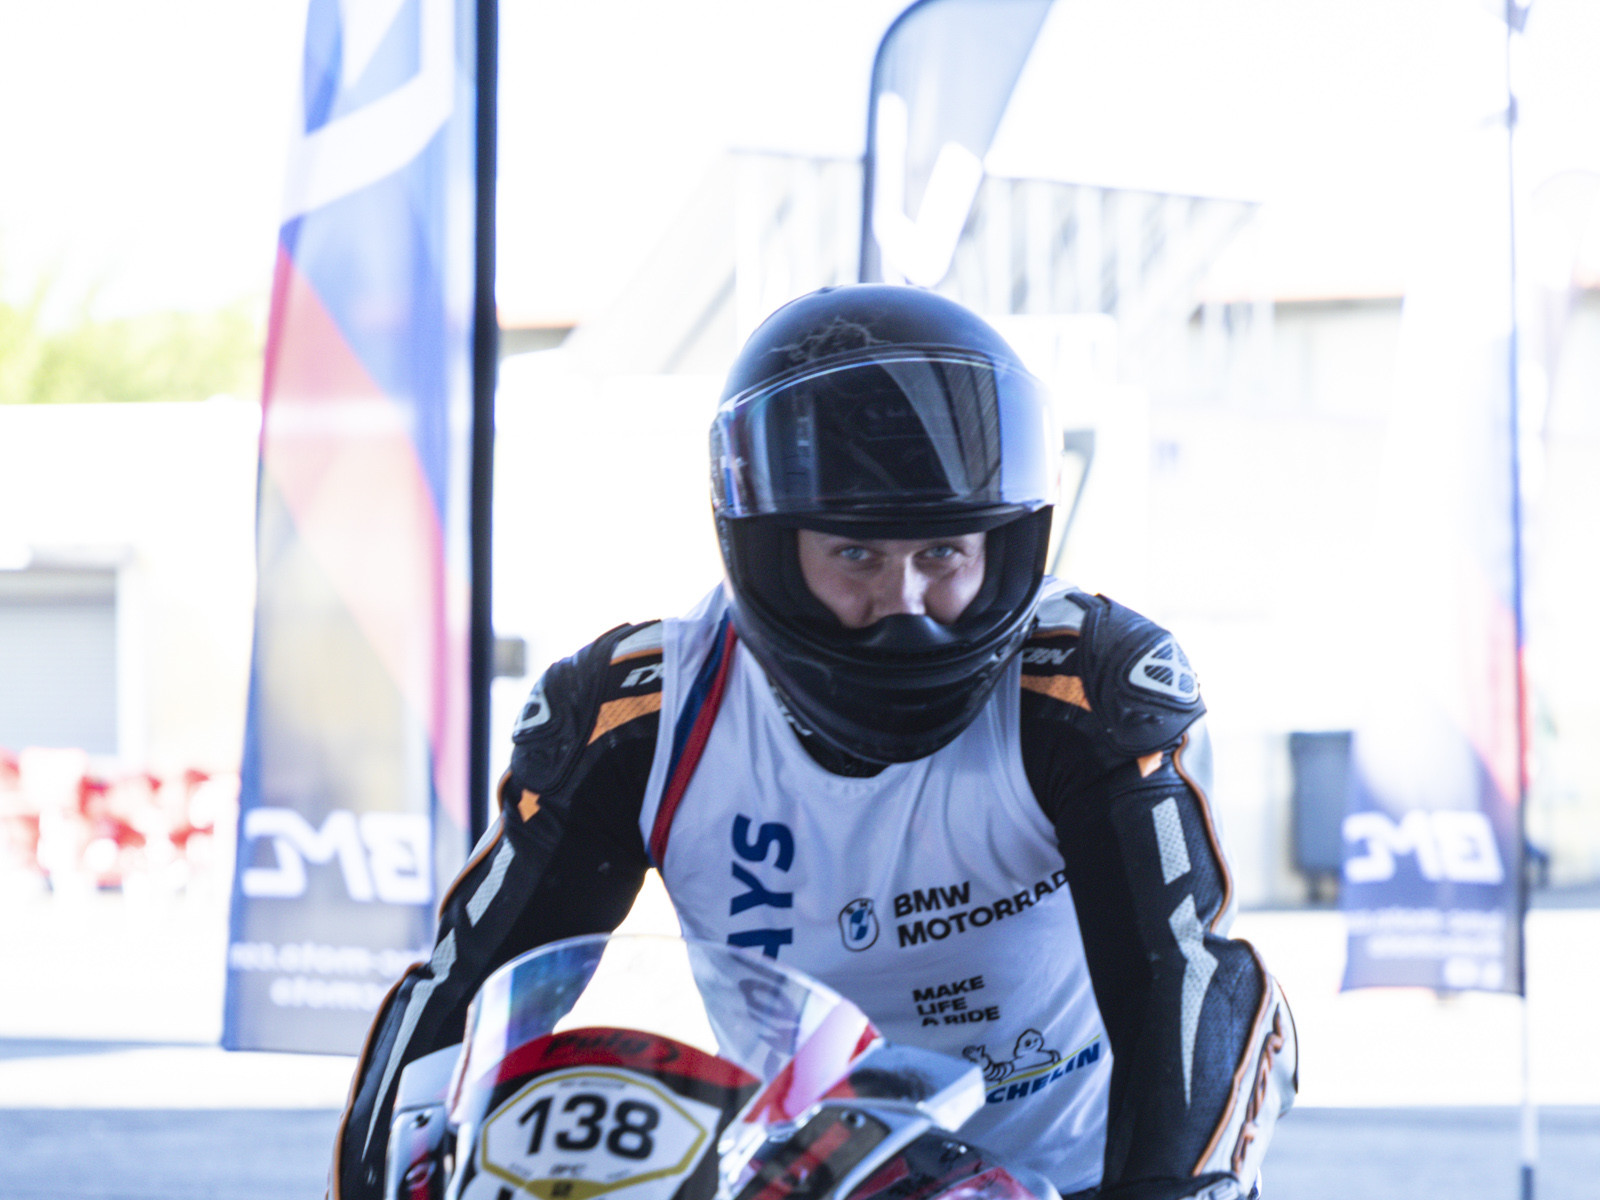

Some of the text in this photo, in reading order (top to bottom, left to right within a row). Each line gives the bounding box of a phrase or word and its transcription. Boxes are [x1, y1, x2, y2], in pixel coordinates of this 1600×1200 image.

[893, 881, 971, 918] BMW
[896, 869, 1067, 948] MOTORRAD
[912, 975, 985, 1002] MAKE
[917, 997, 968, 1016] LIFE
[921, 1006, 1000, 1027] A RIDE
[517, 1092, 661, 1162] 138
